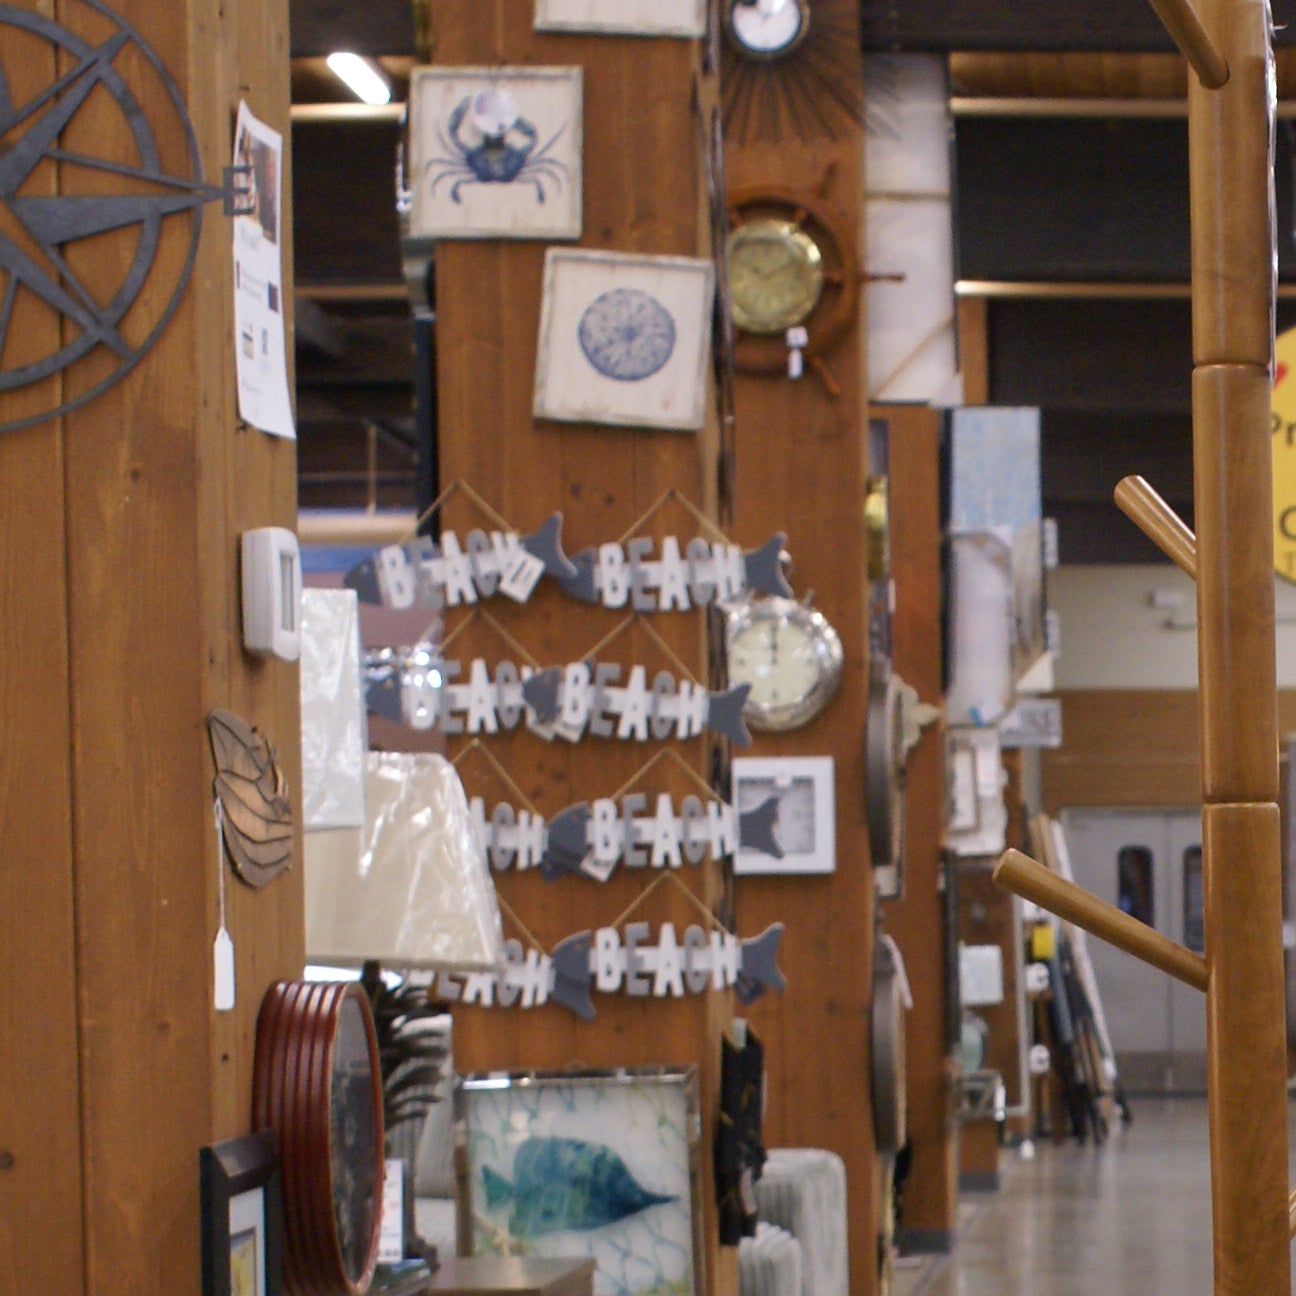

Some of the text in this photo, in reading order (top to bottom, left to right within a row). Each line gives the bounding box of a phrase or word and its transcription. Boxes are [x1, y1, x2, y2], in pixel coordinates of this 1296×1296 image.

[600, 535, 744, 612] BEACH
[408, 657, 534, 734] BEAC
[564, 661, 708, 742] BEACH
[592, 792, 738, 869] BEACH
[595, 922, 740, 997] BEACH
